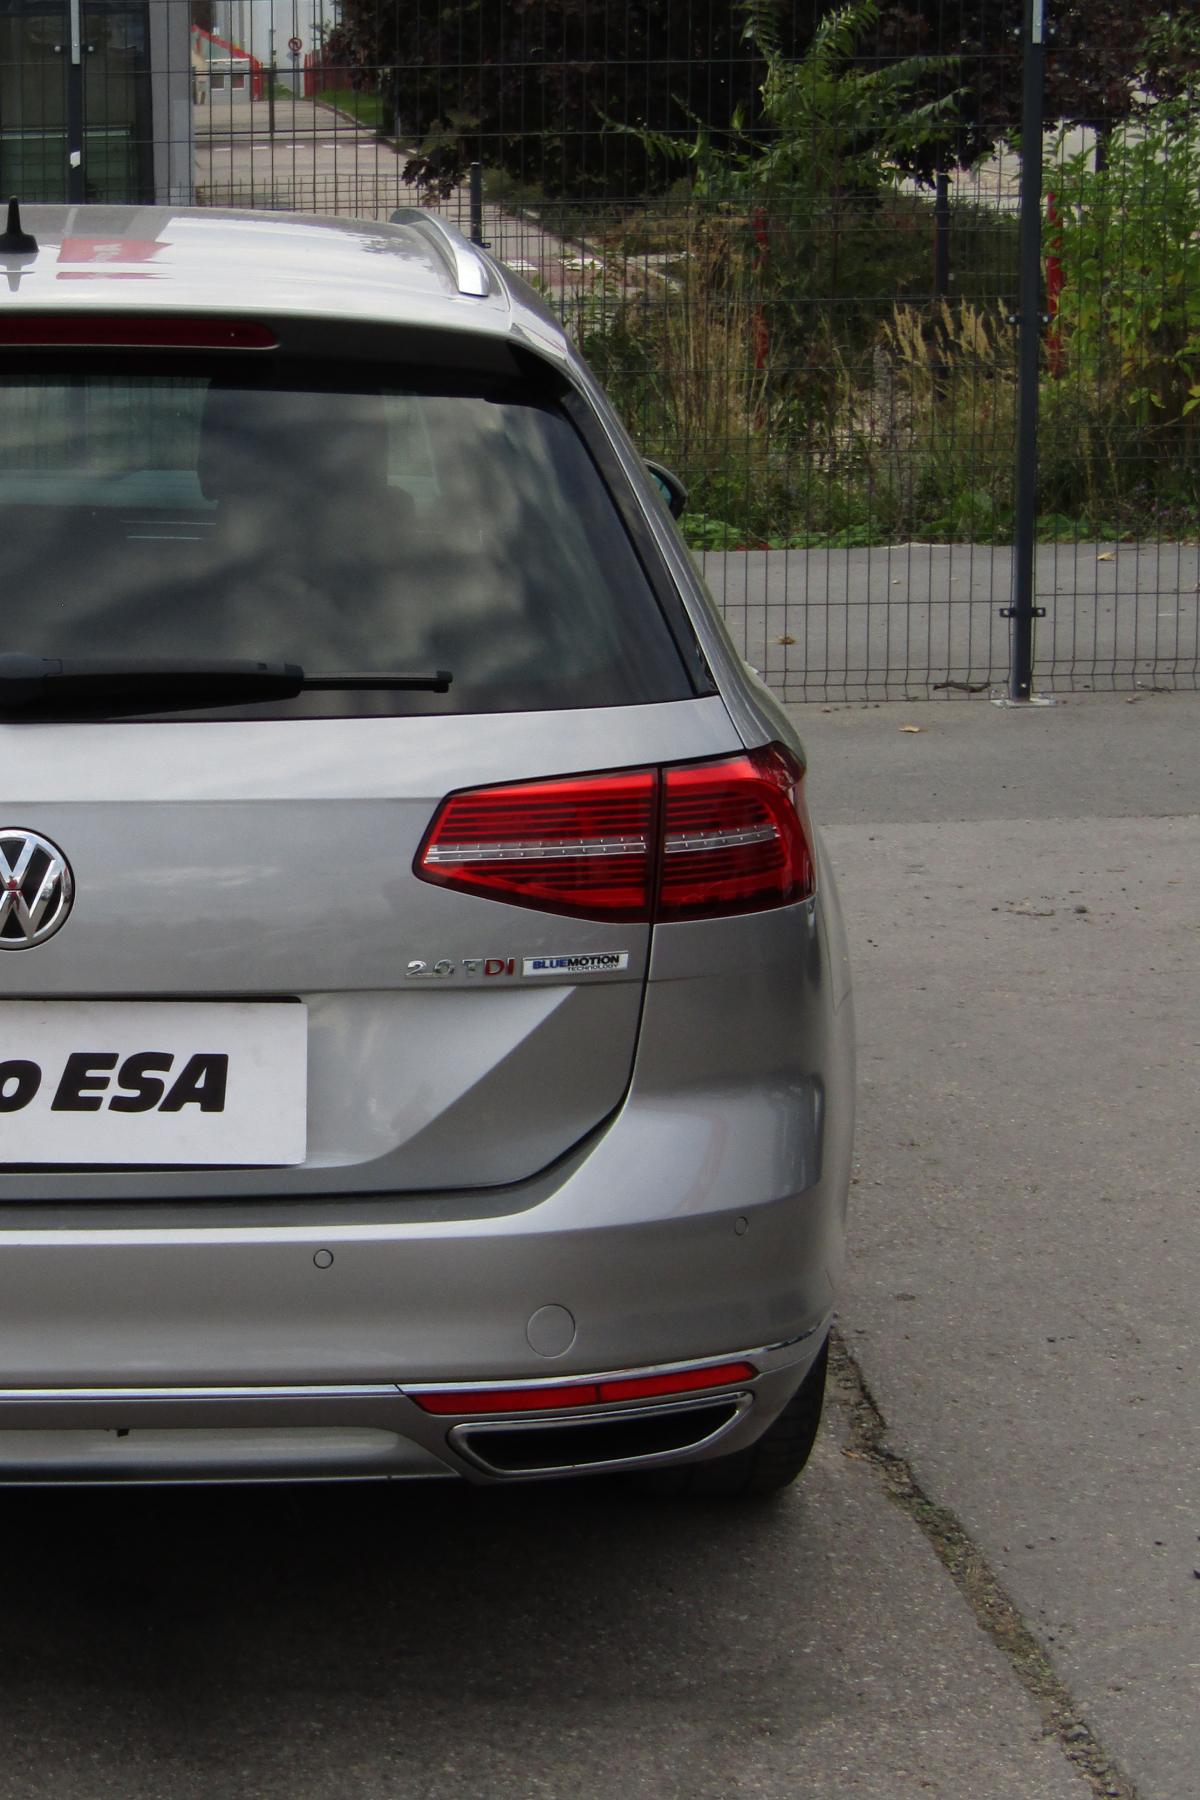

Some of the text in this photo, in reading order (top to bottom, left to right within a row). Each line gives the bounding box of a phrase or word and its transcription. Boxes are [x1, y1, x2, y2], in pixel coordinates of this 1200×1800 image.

[462, 957, 516, 977] TDI
[532, 955, 620, 970] BLUEMOTION
[50, 1051, 229, 1113] ESA
